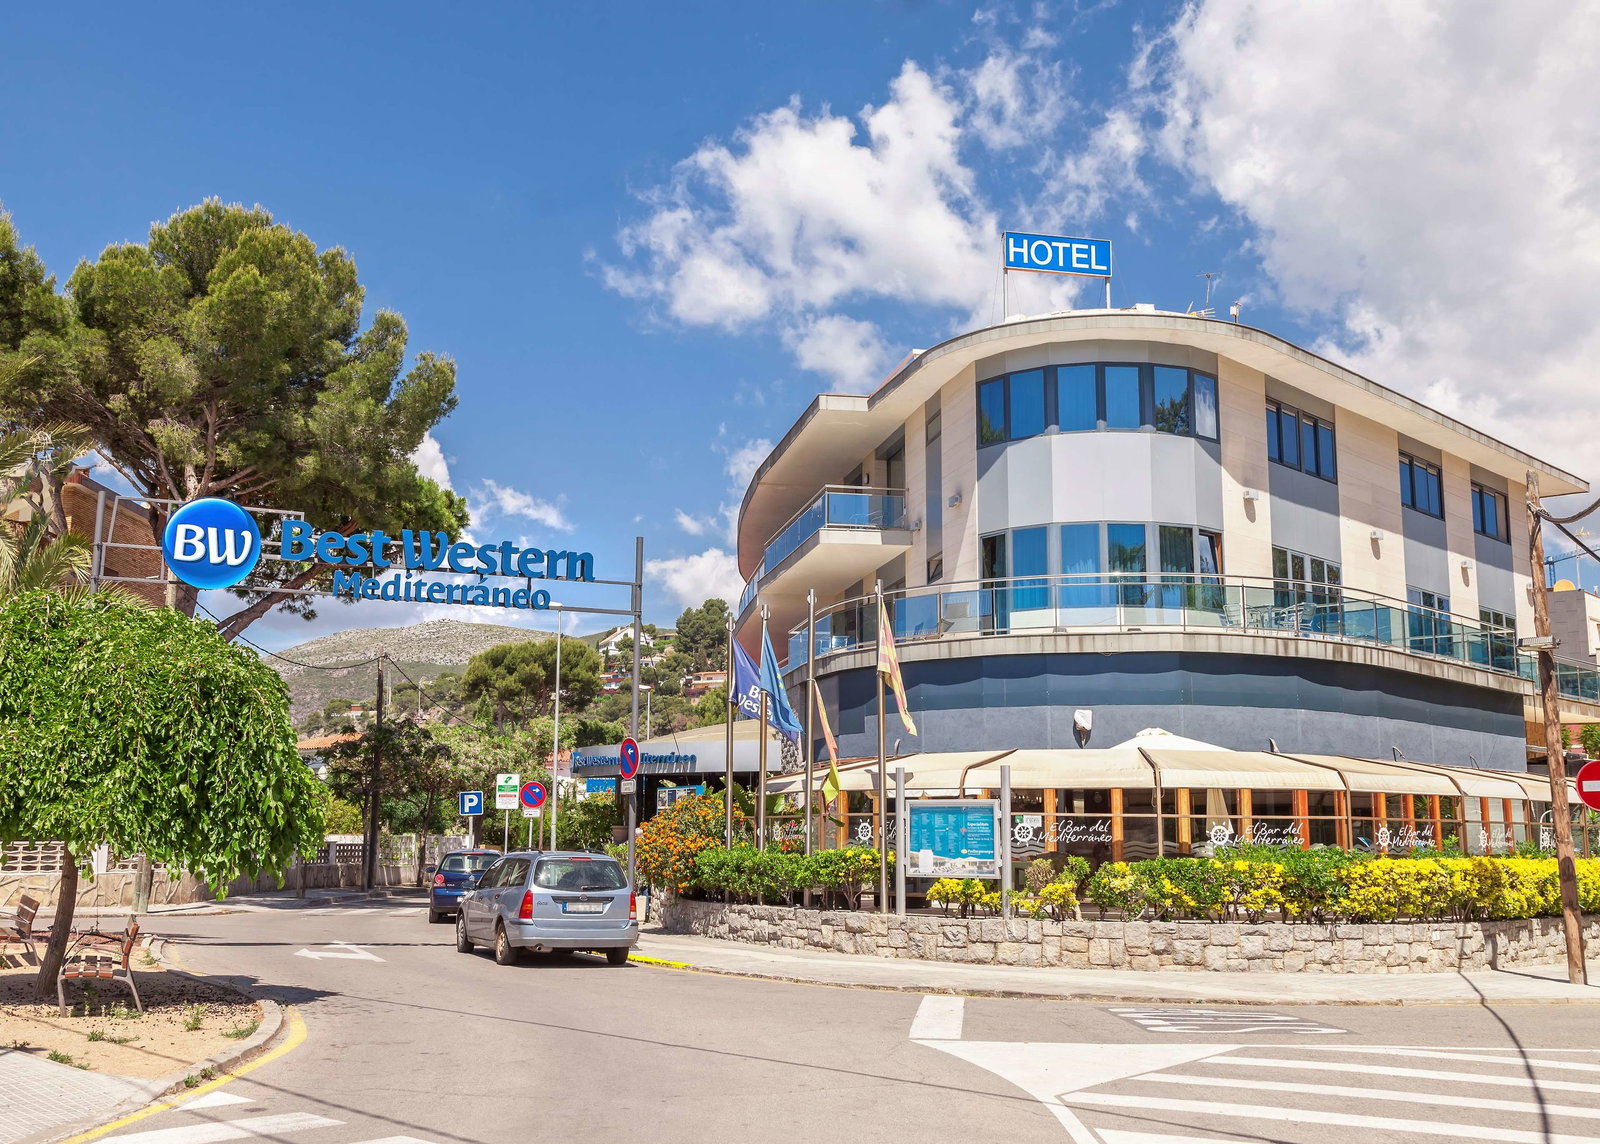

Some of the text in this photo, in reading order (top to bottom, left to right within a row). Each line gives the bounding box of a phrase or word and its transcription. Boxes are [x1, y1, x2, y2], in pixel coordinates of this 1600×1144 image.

[1008, 237, 1108, 271] HOTEL
[173, 523, 253, 566] BW
[280, 519, 596, 582] Best Western
[331, 569, 551, 610] Mediterráneo
[463, 794, 479, 813] P
[1064, 819, 1087, 833] Bar
[1088, 819, 1112, 832] del
[1259, 822, 1281, 835] Bar
[1282, 821, 1304, 835] del
